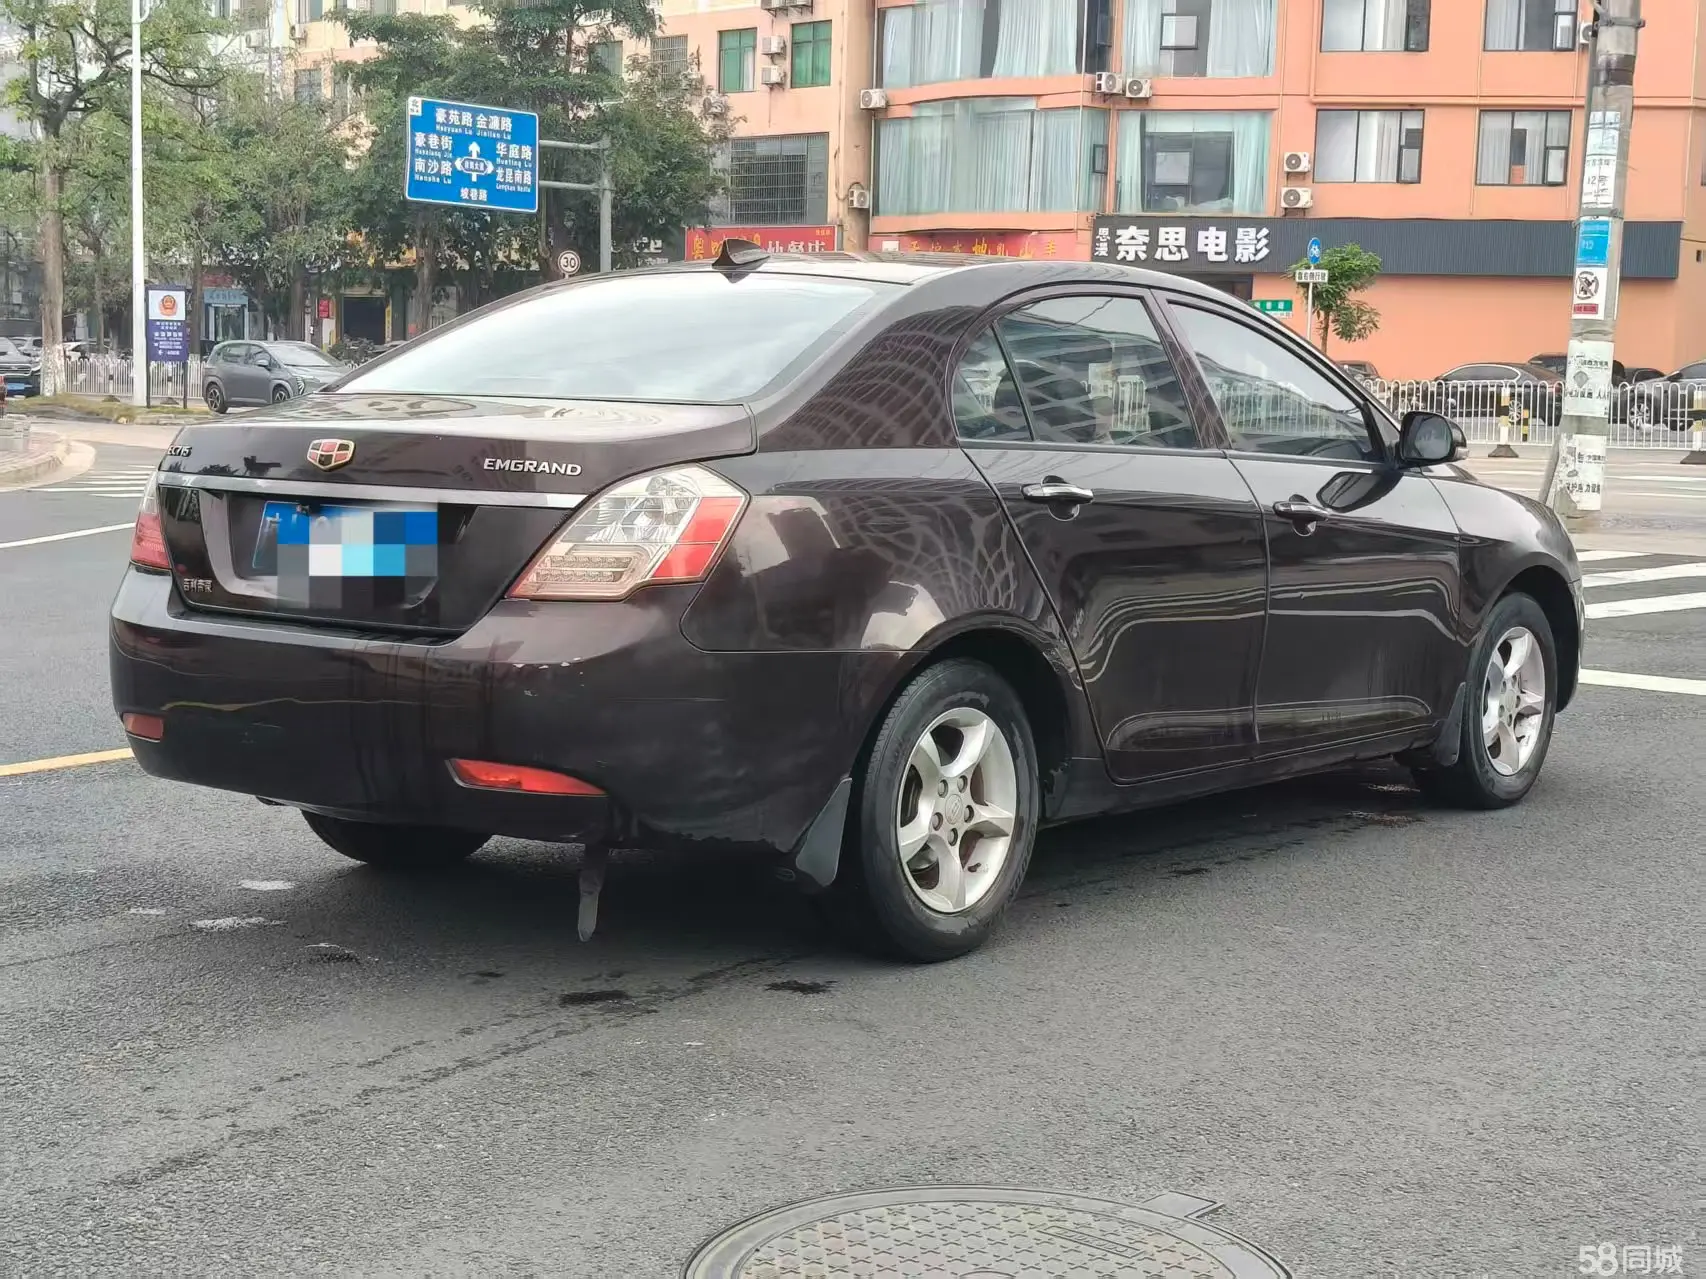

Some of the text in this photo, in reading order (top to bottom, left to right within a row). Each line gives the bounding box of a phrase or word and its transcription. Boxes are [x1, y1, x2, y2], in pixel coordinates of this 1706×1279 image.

[435, 107, 473, 128] 豪苑路
[496, 141, 533, 161] 华庭路
[414, 158, 453, 177] 南沙路
[496, 167, 532, 185] 龙昆南路
[1114, 225, 1272, 263] 奈思电影
[562, 256, 577, 269] 30
[483, 457, 582, 477] EMGRAND
